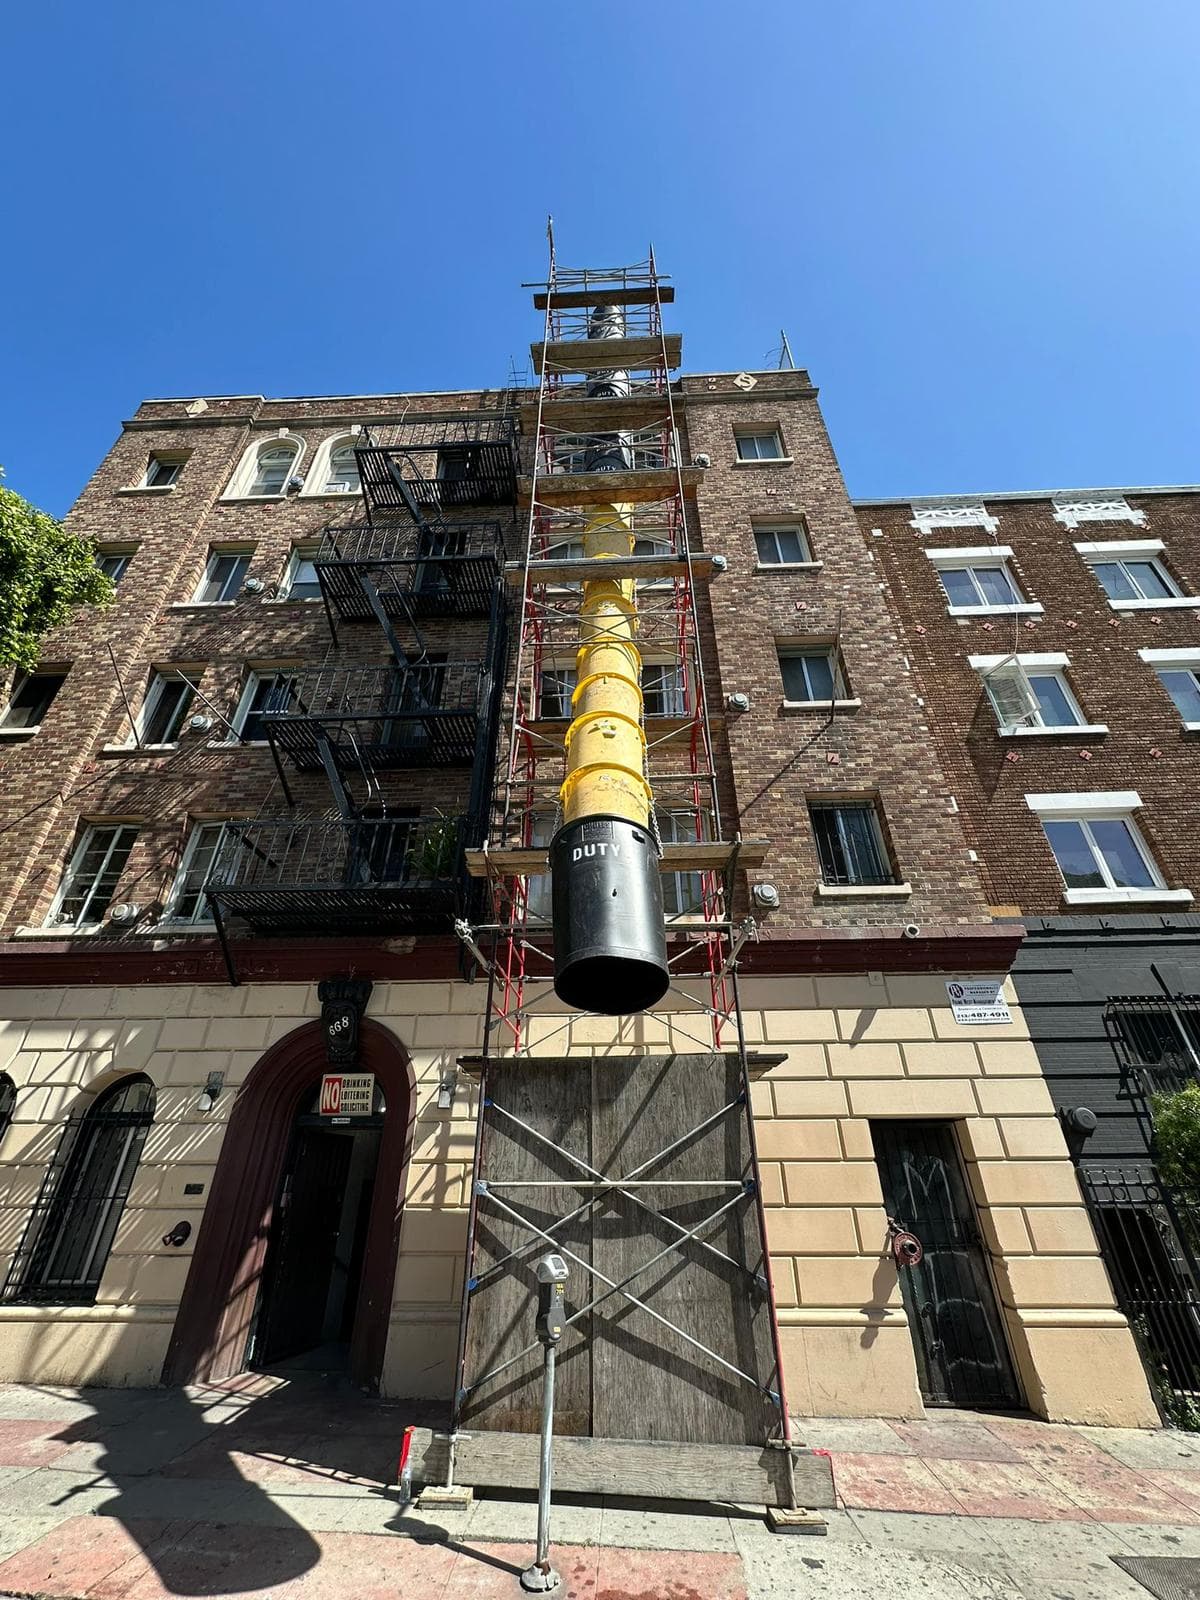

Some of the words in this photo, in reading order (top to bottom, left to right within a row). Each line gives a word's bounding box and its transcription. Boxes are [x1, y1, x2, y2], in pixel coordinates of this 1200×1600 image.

[740, 376, 751, 388] S
[573, 843, 621, 862] DUTY
[329, 1016, 349, 1036] 668
[342, 1079, 371, 1089] DRINKING
[322, 1081, 340, 1110] NO
[340, 1090, 370, 1100] LOITERING
[340, 1102, 369, 1112] SOLICITING
